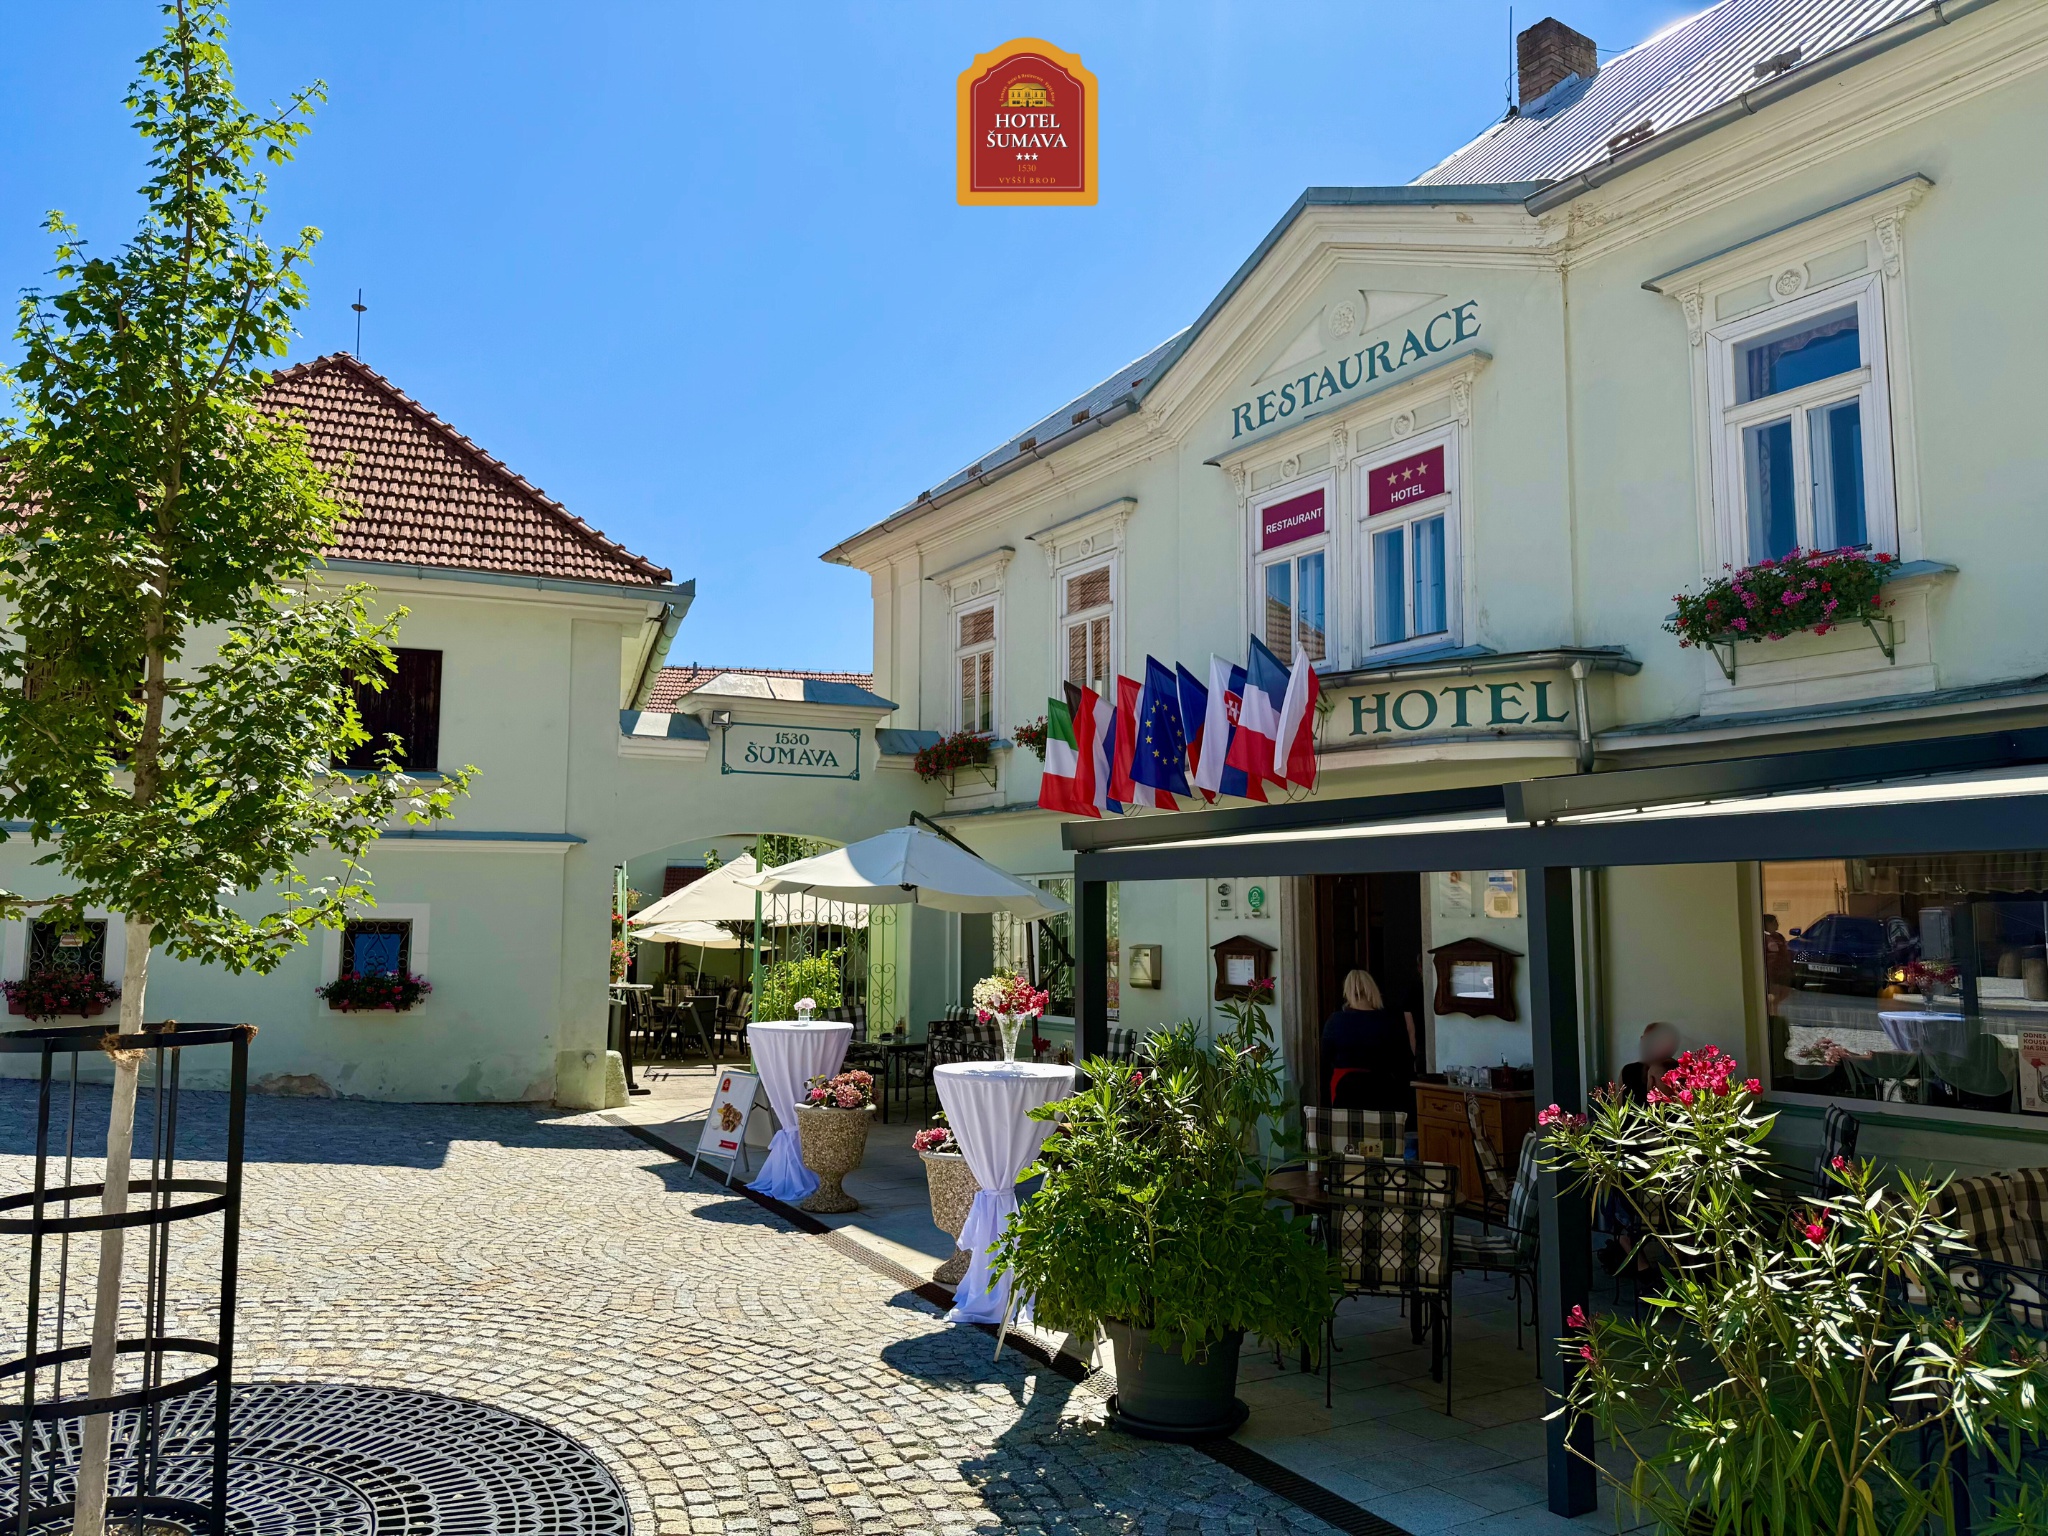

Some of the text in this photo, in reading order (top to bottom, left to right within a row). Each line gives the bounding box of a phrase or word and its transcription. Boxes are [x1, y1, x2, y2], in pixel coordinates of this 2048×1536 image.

[1231, 299, 1482, 440] RESTAURACE
[1390, 484, 1425, 503] HOTEL
[1265, 507, 1323, 535] RESTAURANT
[1348, 680, 1570, 737] HOTEL
[775, 732, 810, 745] 1530
[744, 741, 840, 768] ŠUMAVA
